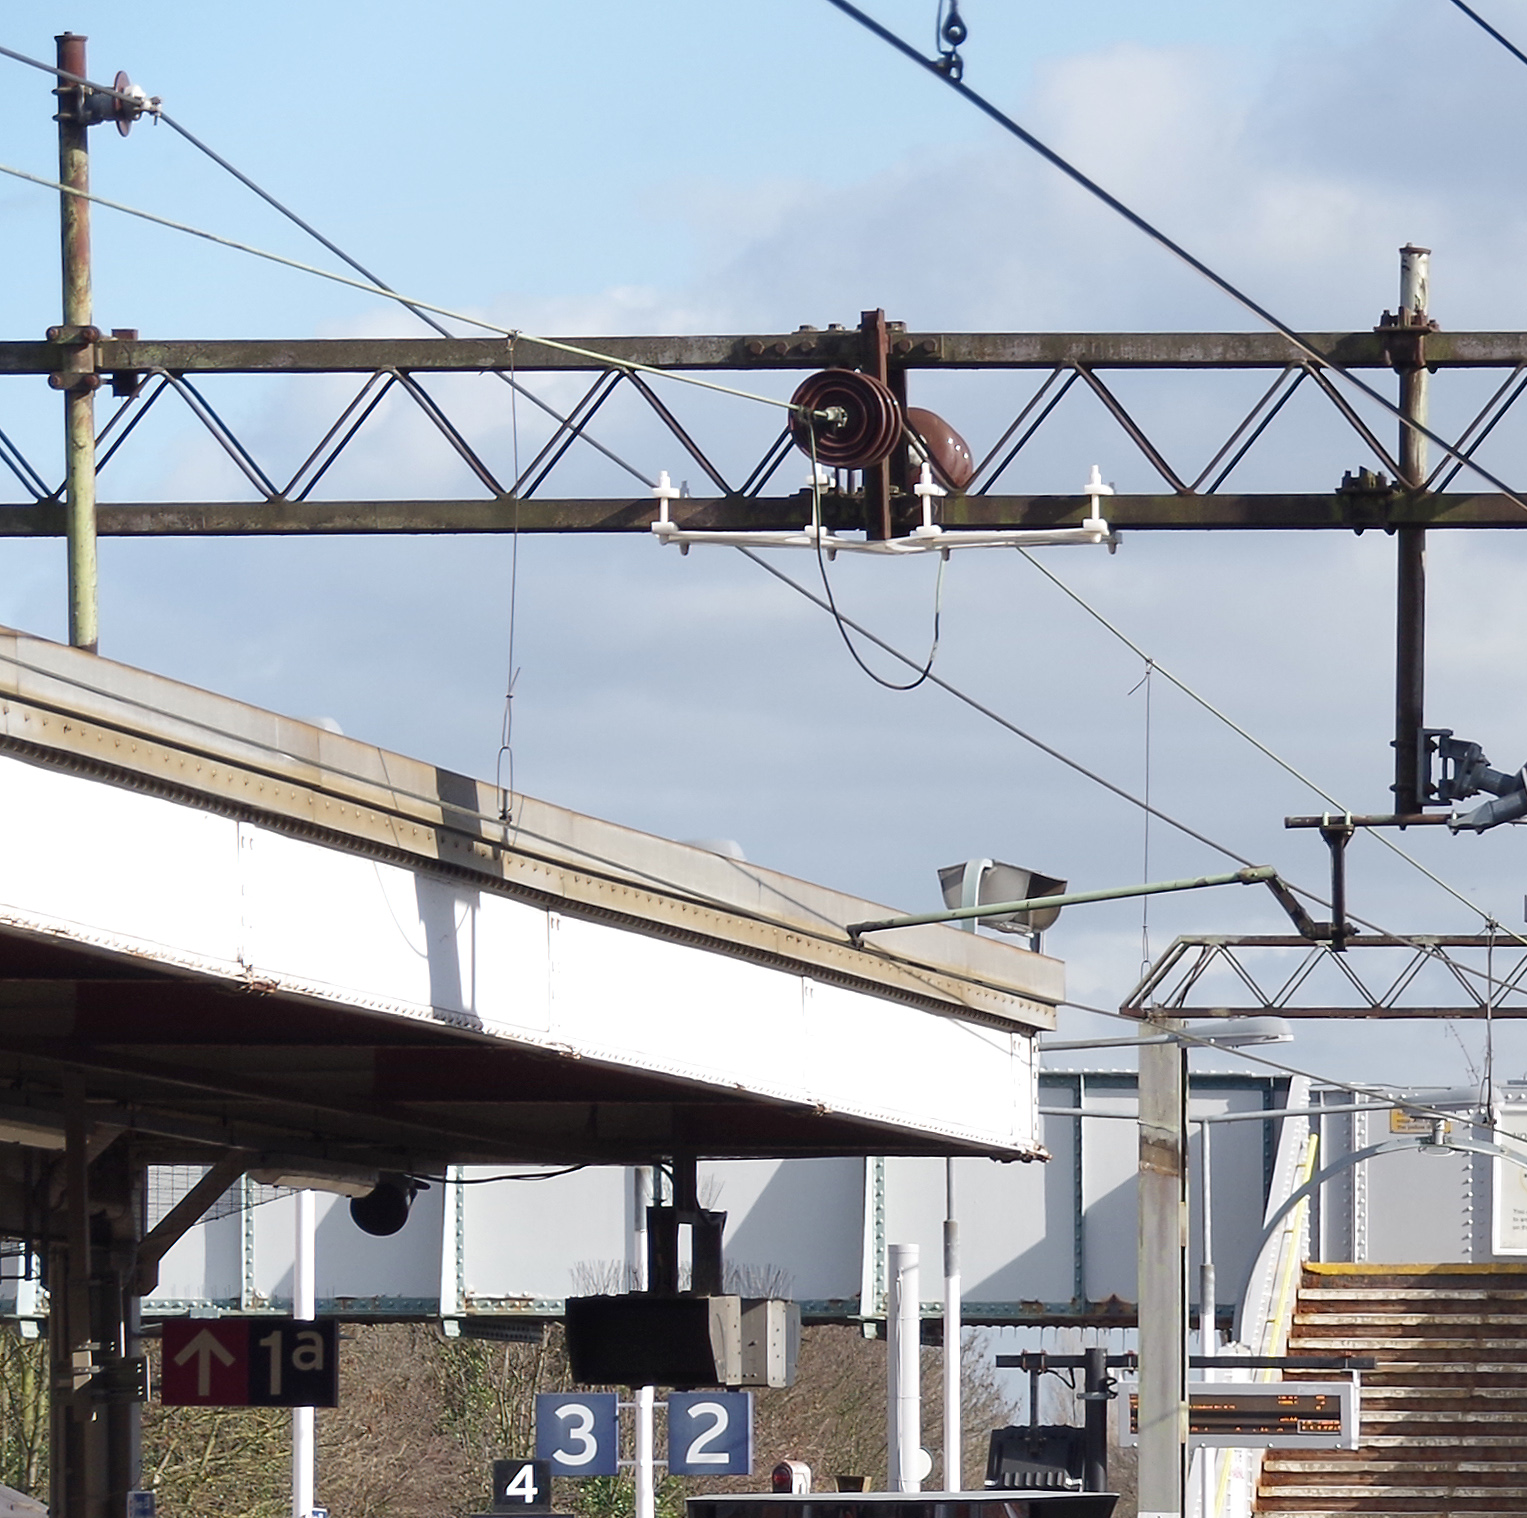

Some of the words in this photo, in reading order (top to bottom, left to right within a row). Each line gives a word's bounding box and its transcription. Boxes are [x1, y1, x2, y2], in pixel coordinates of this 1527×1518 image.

[259, 1329, 324, 1396] 1a
[552, 1403, 598, 1466] 3
[685, 1401, 730, 1464] 2
[505, 1463, 539, 1504] 4
